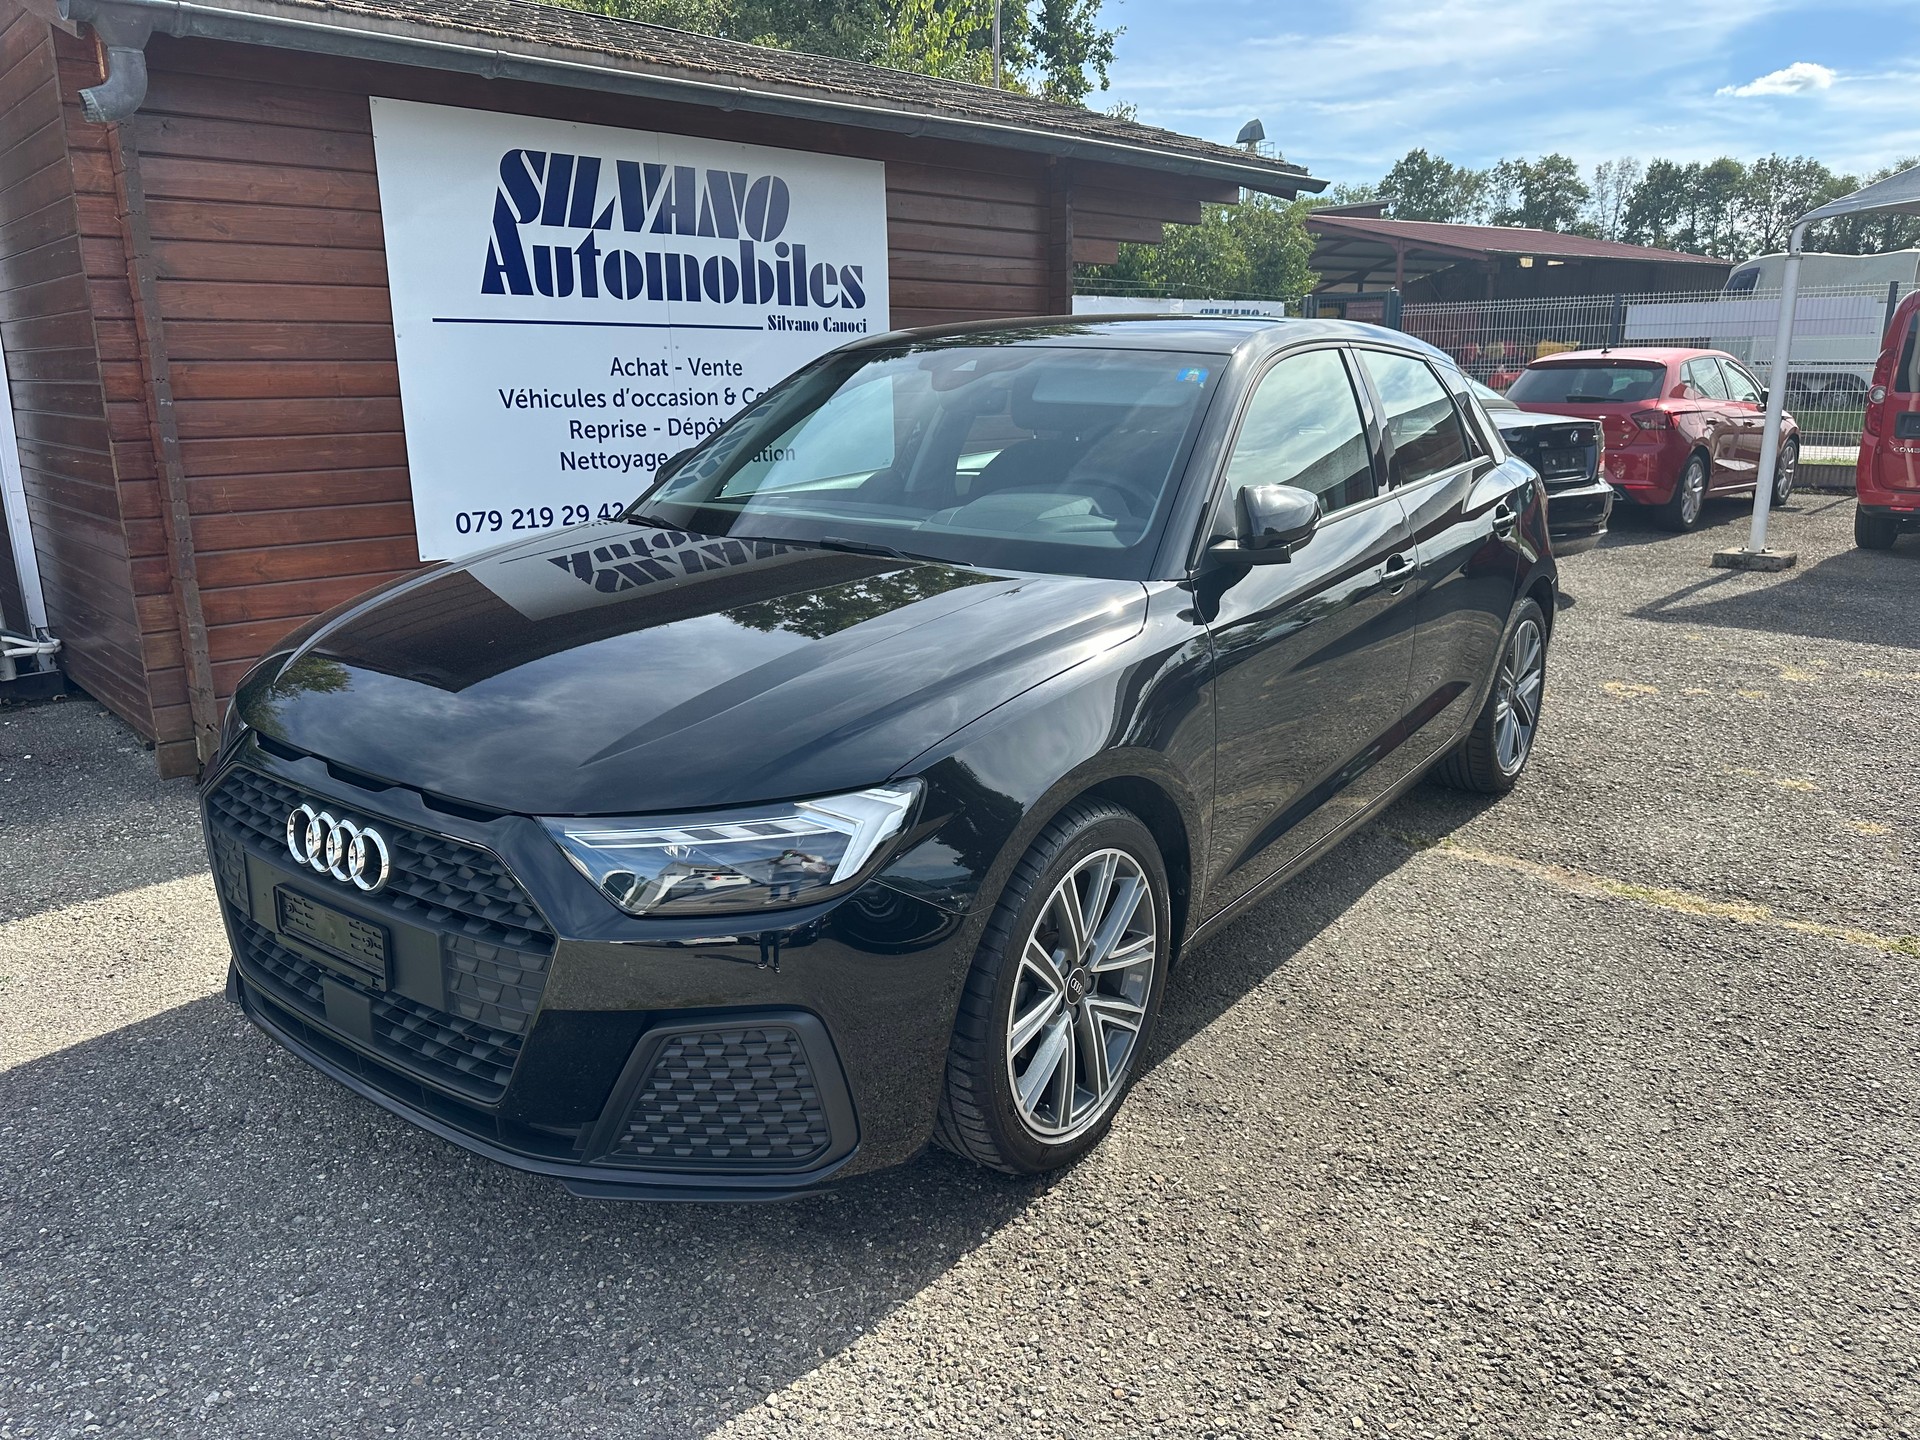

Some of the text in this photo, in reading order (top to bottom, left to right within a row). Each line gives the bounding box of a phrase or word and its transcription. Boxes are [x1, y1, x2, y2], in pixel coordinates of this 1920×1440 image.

[496, 148, 790, 242] SILVANO
[481, 212, 866, 309] Automobiles
[767, 314, 867, 333] Silvano Canoci
[610, 356, 669, 377] Achat
[687, 357, 743, 377] Vente
[498, 388, 607, 409] Véhicules
[724, 387, 737, 406] &
[569, 418, 647, 443] Reprise
[559, 451, 669, 473] Nettoyage
[455, 502, 624, 534] 079 219 29 42
